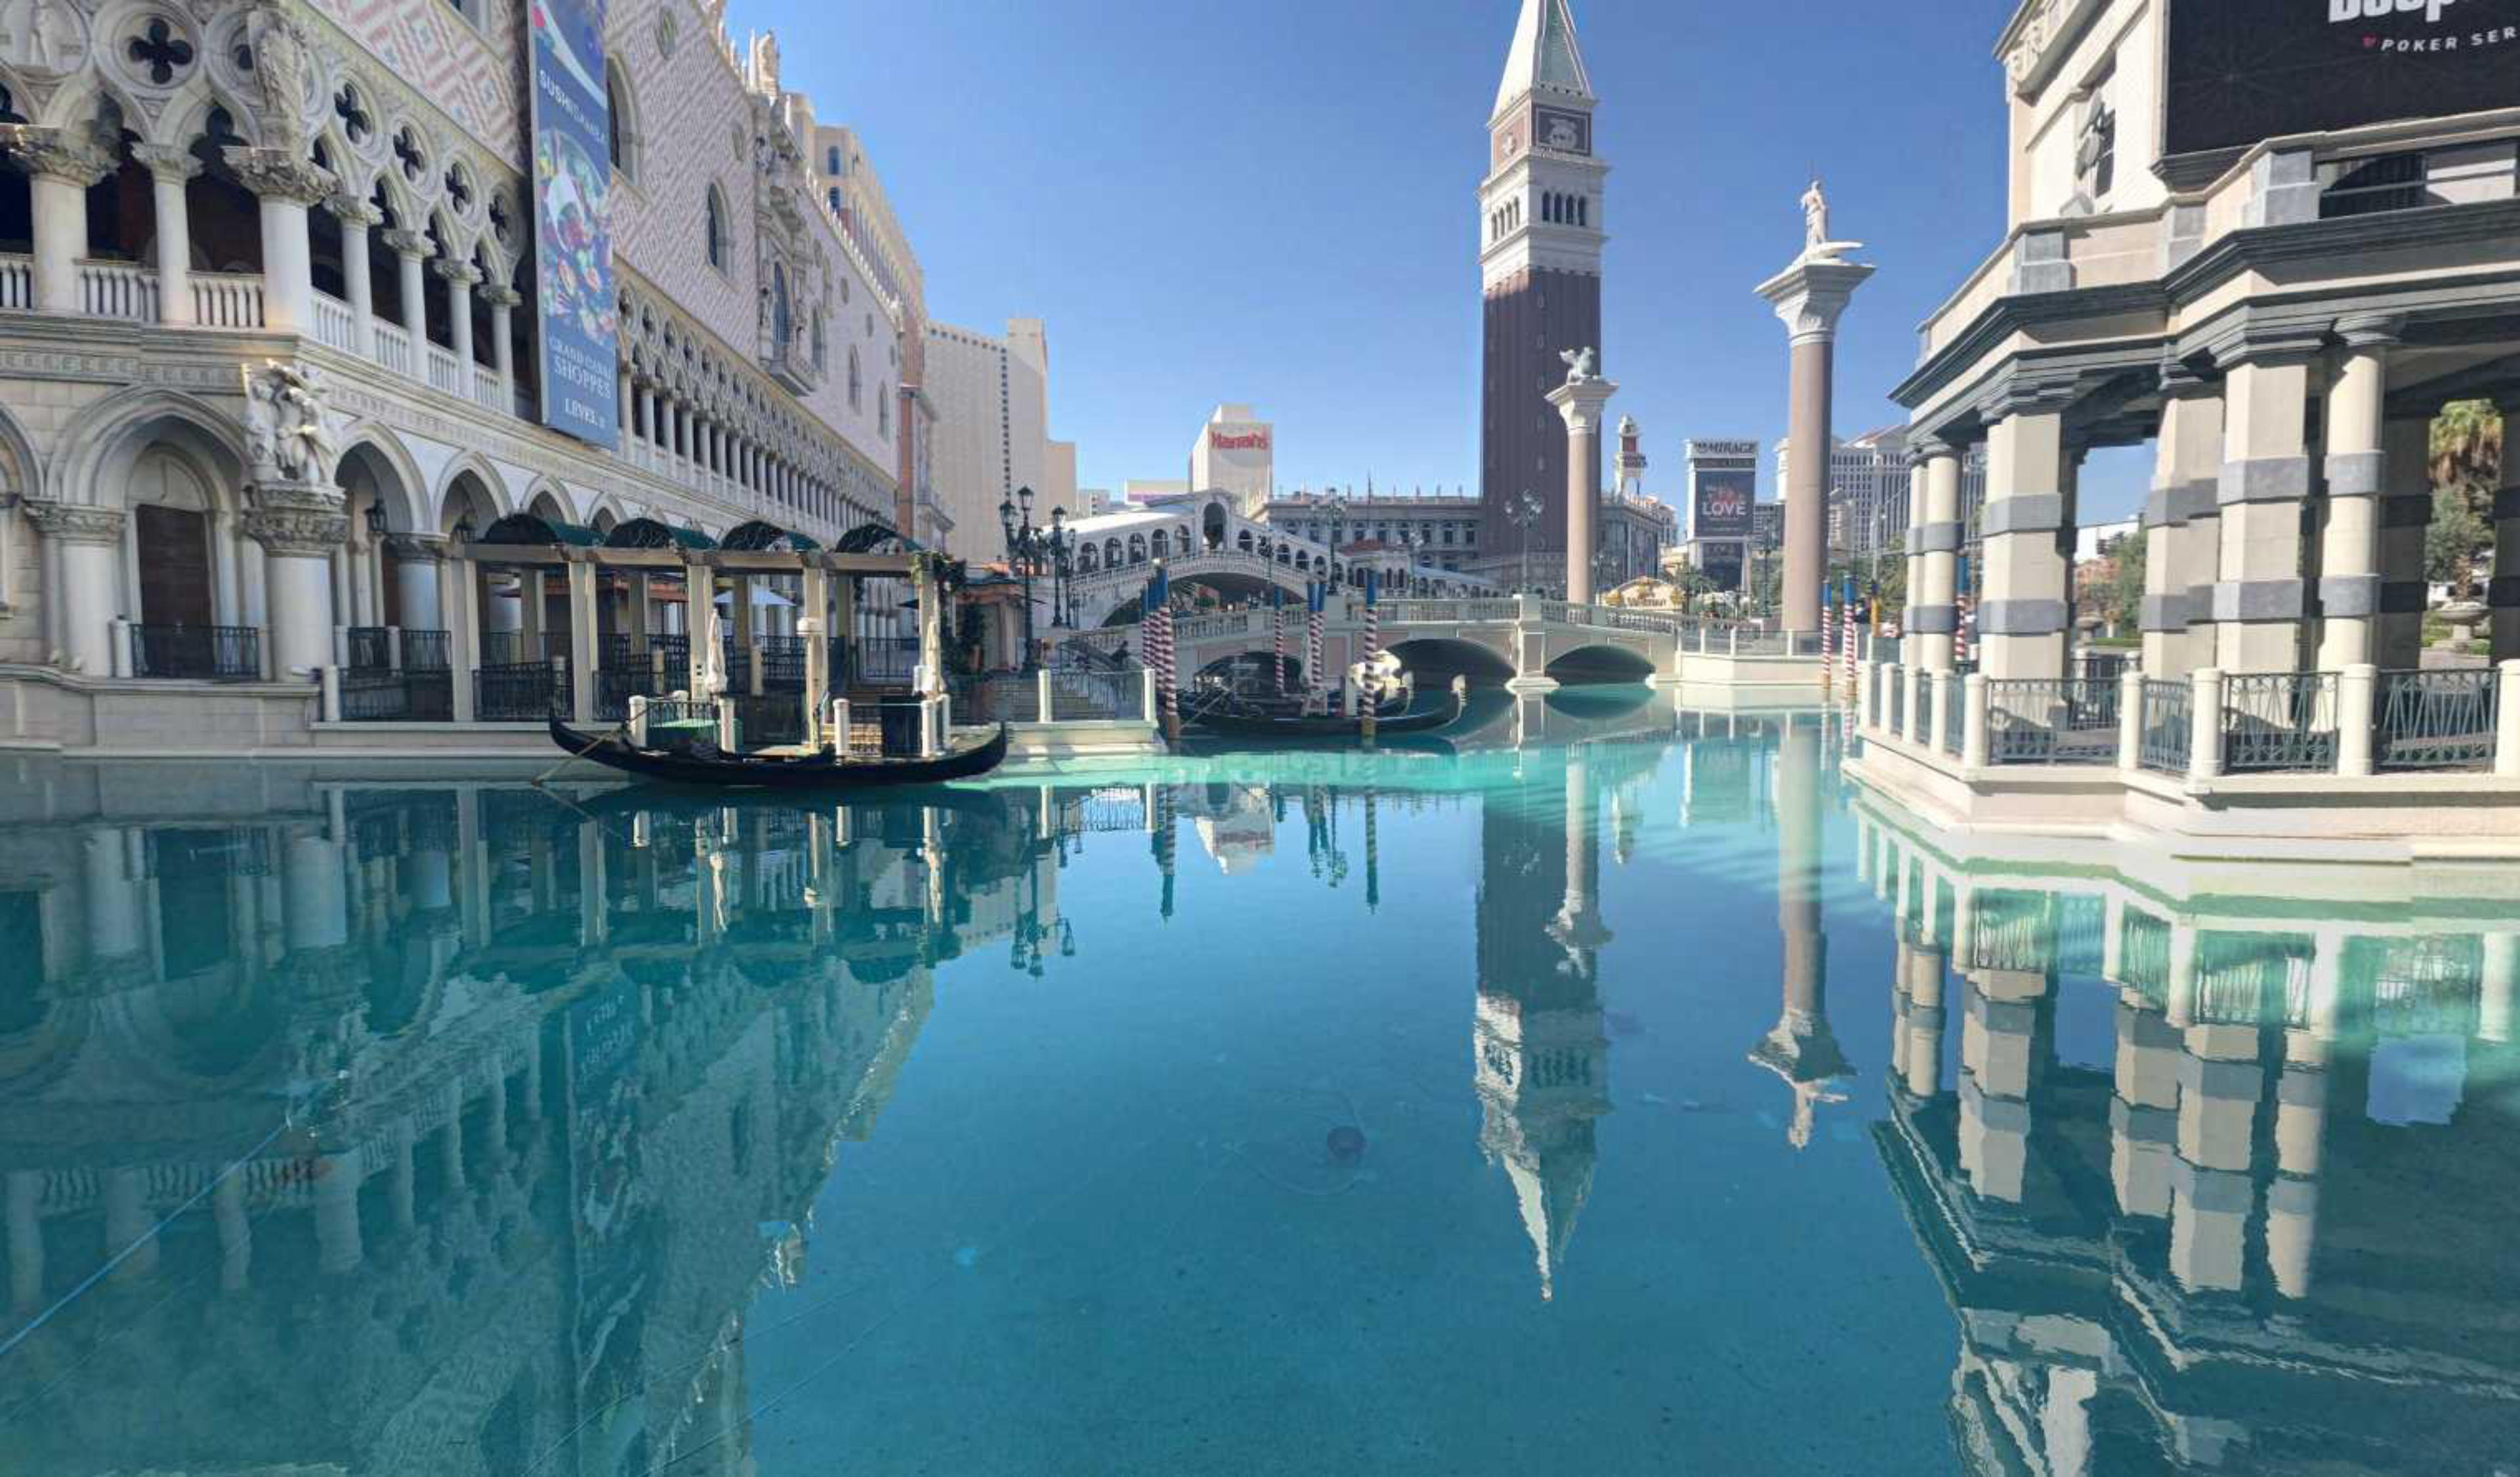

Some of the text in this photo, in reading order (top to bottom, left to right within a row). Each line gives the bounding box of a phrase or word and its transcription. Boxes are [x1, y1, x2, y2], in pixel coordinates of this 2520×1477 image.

[2380, 35, 2458, 53] POKER
[554, 356, 612, 399] SHOPPES
[564, 397, 598, 426] LEVEL
[1709, 440, 1757, 454] MIRAGE
[1702, 501, 1747, 516] LOVE
